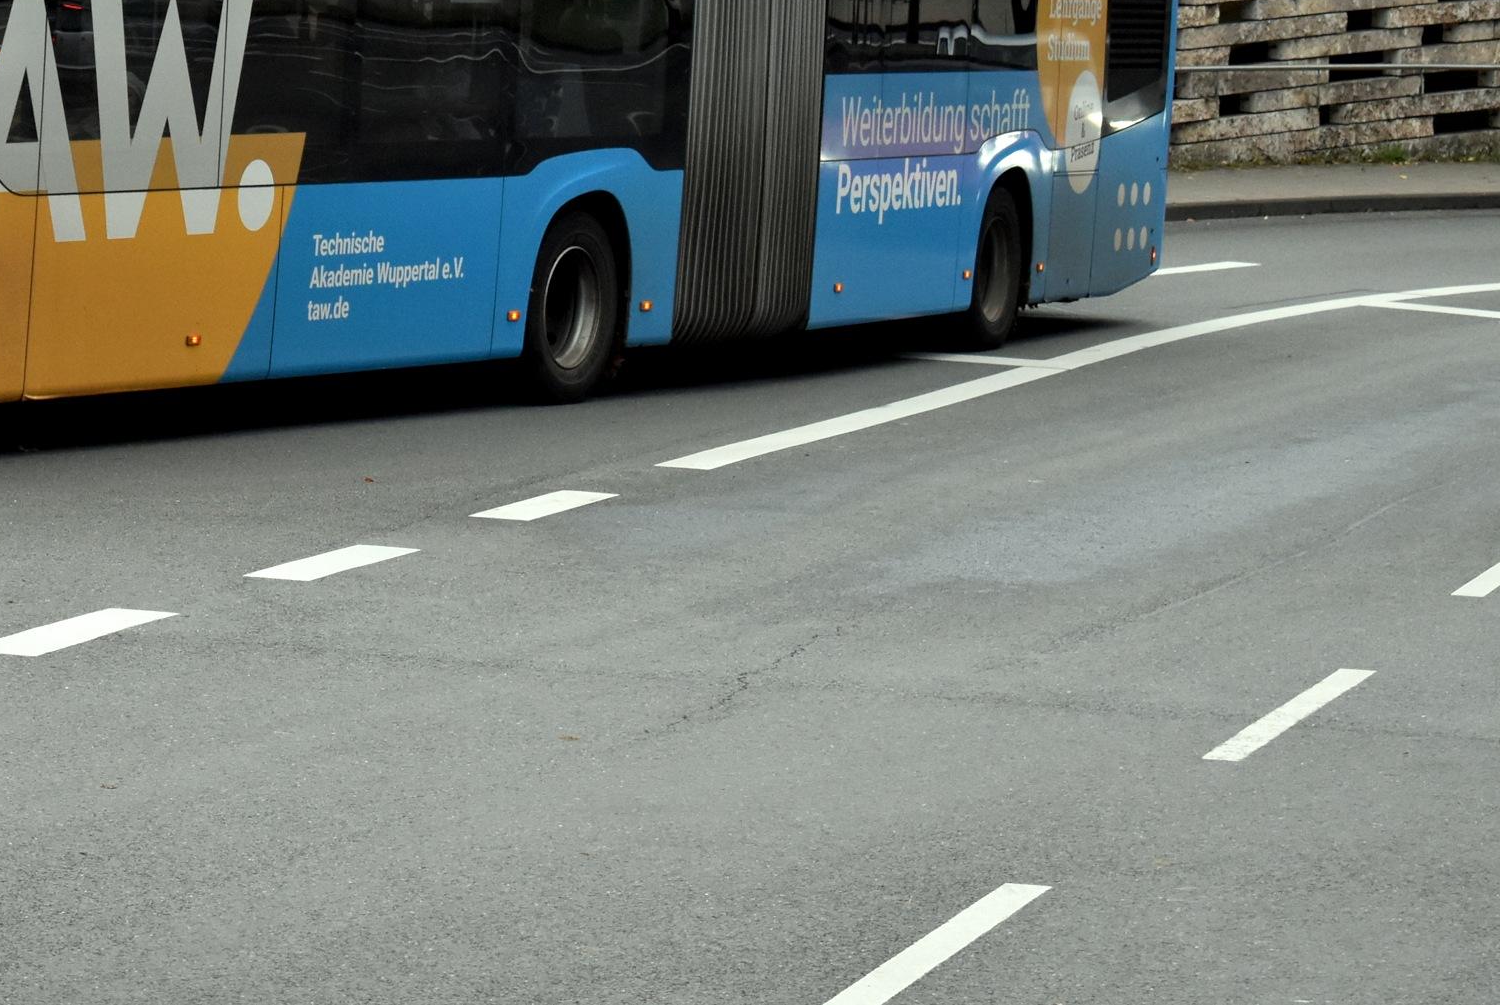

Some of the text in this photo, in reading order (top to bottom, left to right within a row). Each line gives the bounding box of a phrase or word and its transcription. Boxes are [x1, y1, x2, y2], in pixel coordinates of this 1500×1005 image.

[1047, 33, 1091, 61] Studium
[842, 87, 1030, 154] Weiterbildung schafft
[835, 157, 961, 225] Perspektiven.
[313, 230, 385, 256] Technische
[309, 263, 373, 289] Akademie
[377, 257, 440, 289] Wuppertal
[307, 296, 349, 321] taw.de
